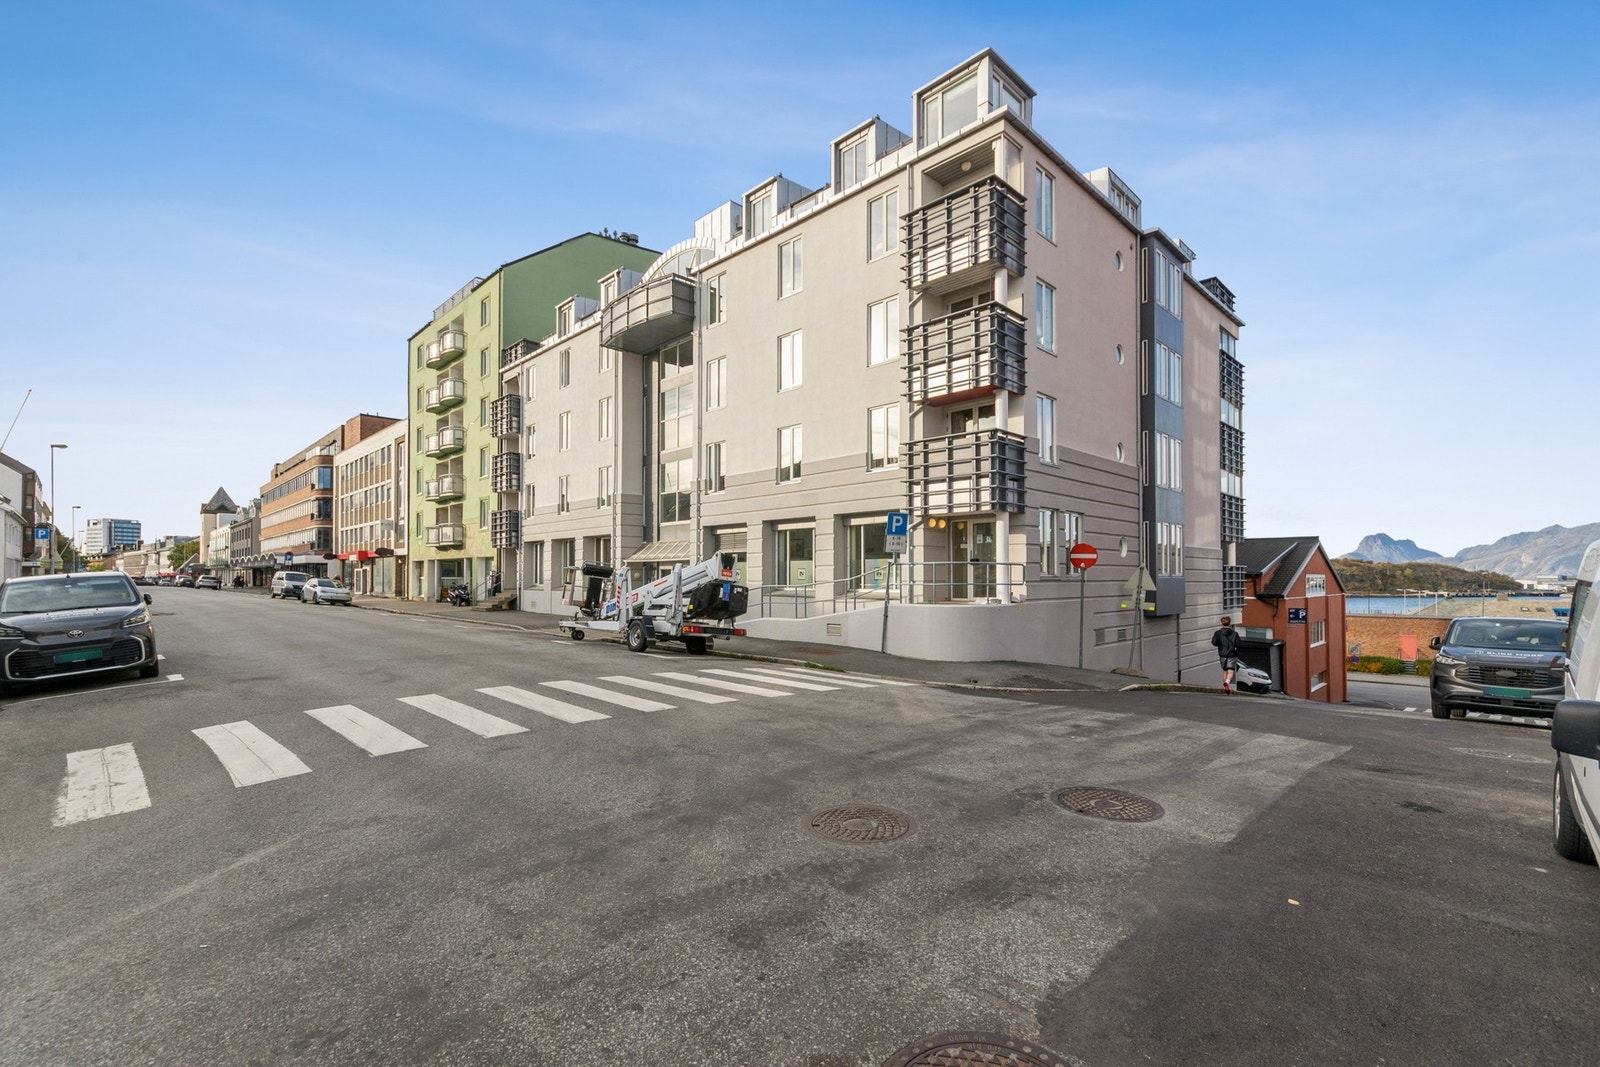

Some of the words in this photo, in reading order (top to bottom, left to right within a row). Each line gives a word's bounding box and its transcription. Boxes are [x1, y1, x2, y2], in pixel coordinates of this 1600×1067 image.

[892, 515, 903, 533] P
[38, 530, 46, 538] P
[1299, 611, 1306, 619] P
